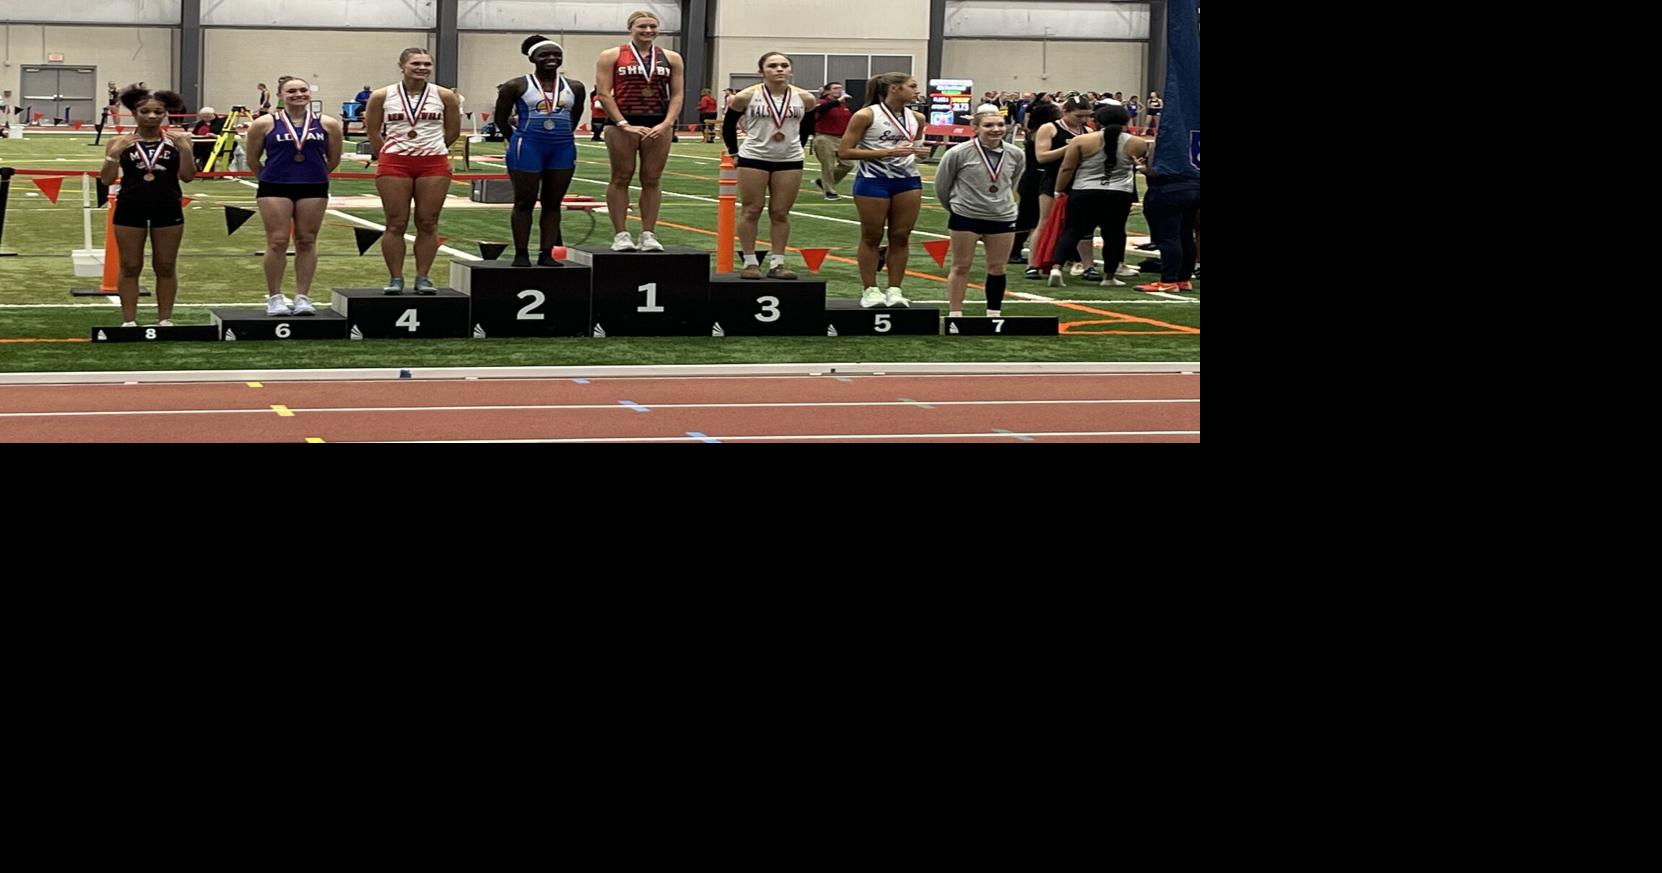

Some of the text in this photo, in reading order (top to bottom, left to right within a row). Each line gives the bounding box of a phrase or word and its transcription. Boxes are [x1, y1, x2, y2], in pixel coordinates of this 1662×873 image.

[617, 64, 671, 77] SHEBY
[275, 132, 325, 142] LOAN
[516, 289, 546, 320] 2
[637, 282, 665, 313] 1
[754, 295, 781, 323] 3
[395, 308, 421, 332] 4
[873, 313, 892, 333] 5
[991, 319, 1005, 333] 7
[145, 328, 157, 340] 8
[275, 322, 291, 339] 6
